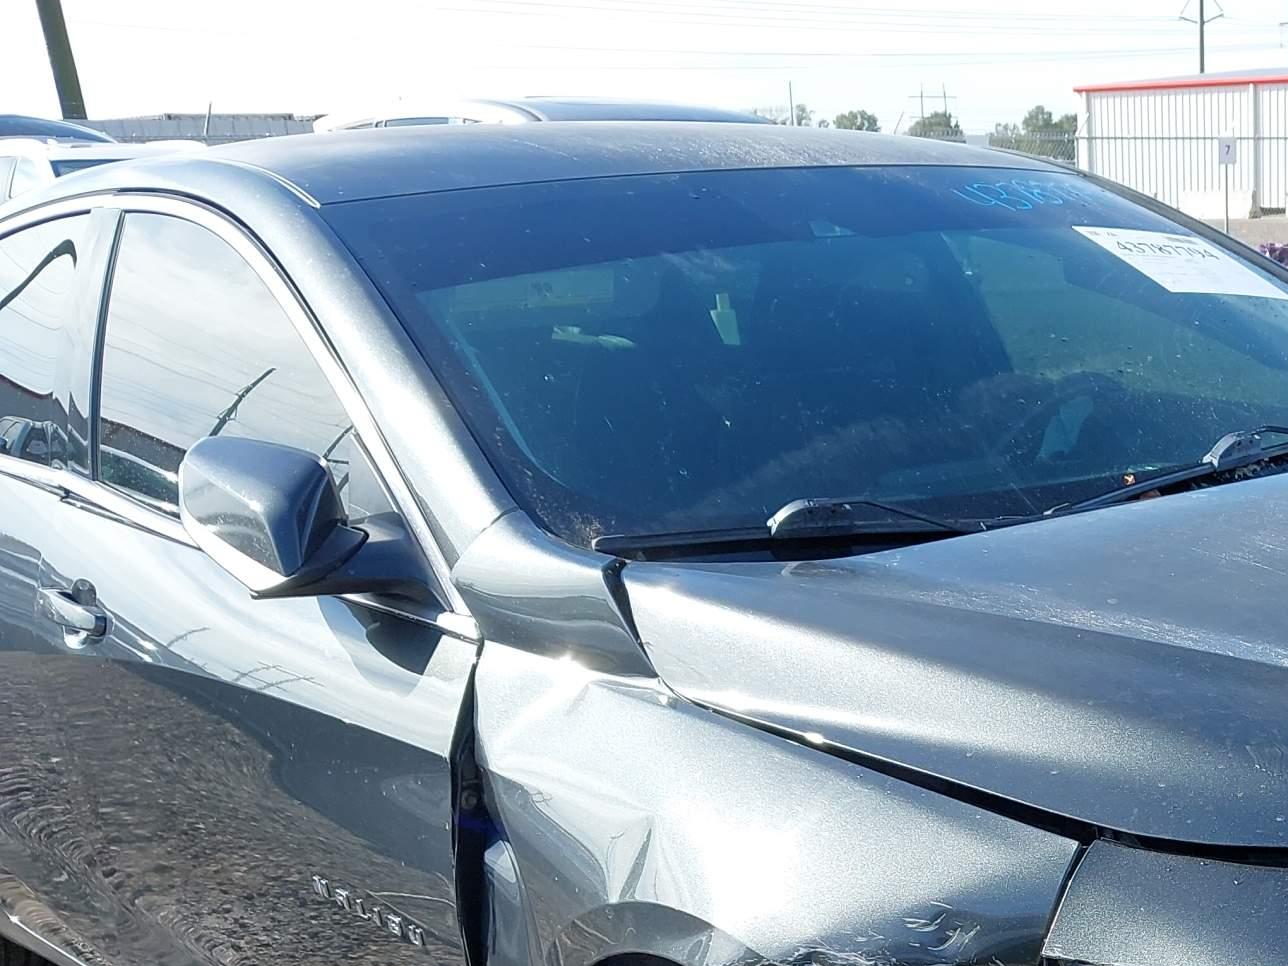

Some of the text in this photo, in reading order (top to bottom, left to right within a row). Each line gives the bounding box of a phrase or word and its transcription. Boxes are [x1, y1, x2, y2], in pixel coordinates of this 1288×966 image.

[1225, 144, 1231, 155] 7
[1116, 240, 1221, 260] 43787794
[312, 874, 426, 948] MALIBU
